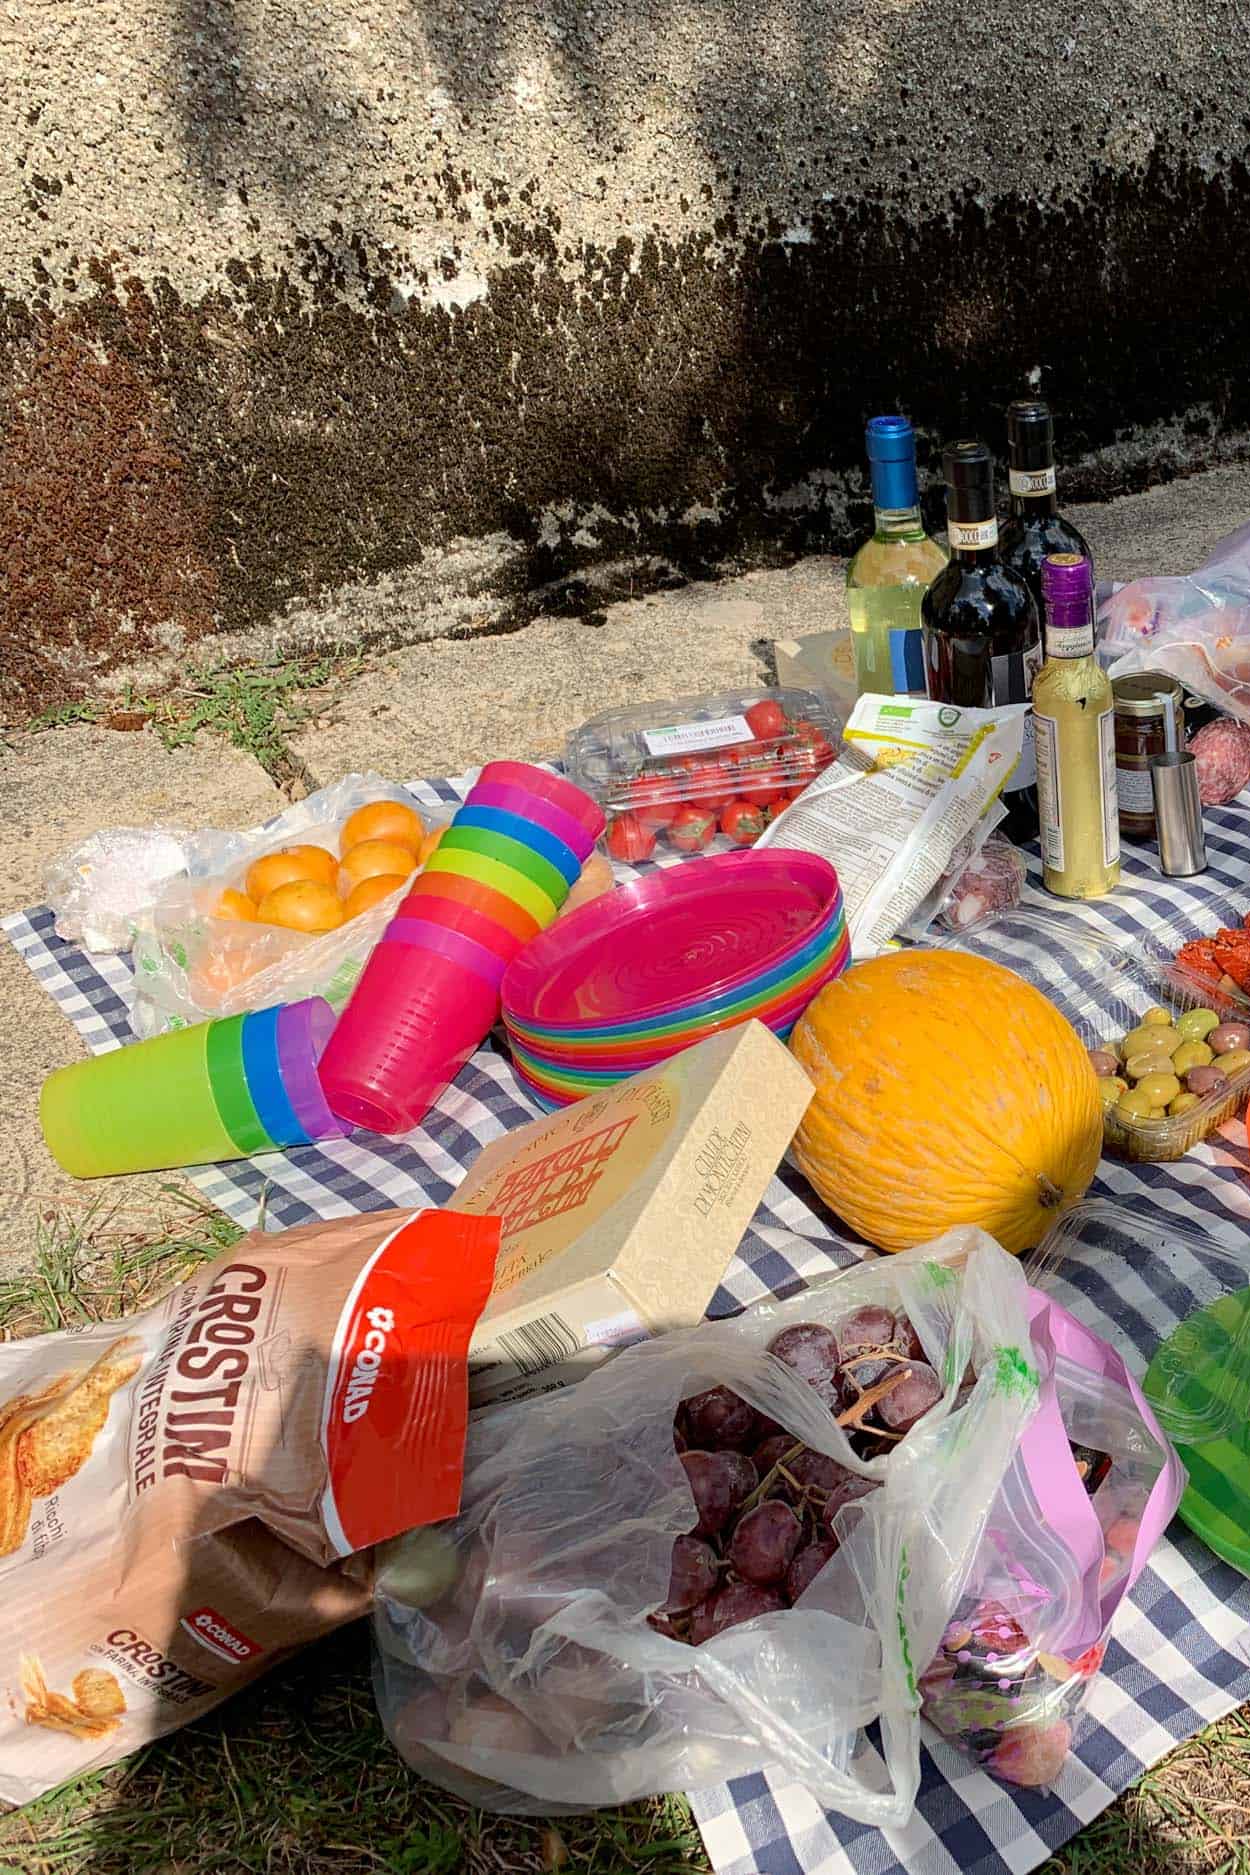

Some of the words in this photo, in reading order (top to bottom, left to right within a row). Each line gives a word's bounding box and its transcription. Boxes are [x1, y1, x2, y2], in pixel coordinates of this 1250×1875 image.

[163, 1263, 267, 1483] CROSTINI
[343, 1329, 385, 1424] CONAD
[136, 1365, 172, 1496] INTEGRALE
[44, 1495, 68, 1541] Ricchi
[106, 1629, 217, 1698] CROSTINI
[207, 1624, 250, 1656] CONAD
